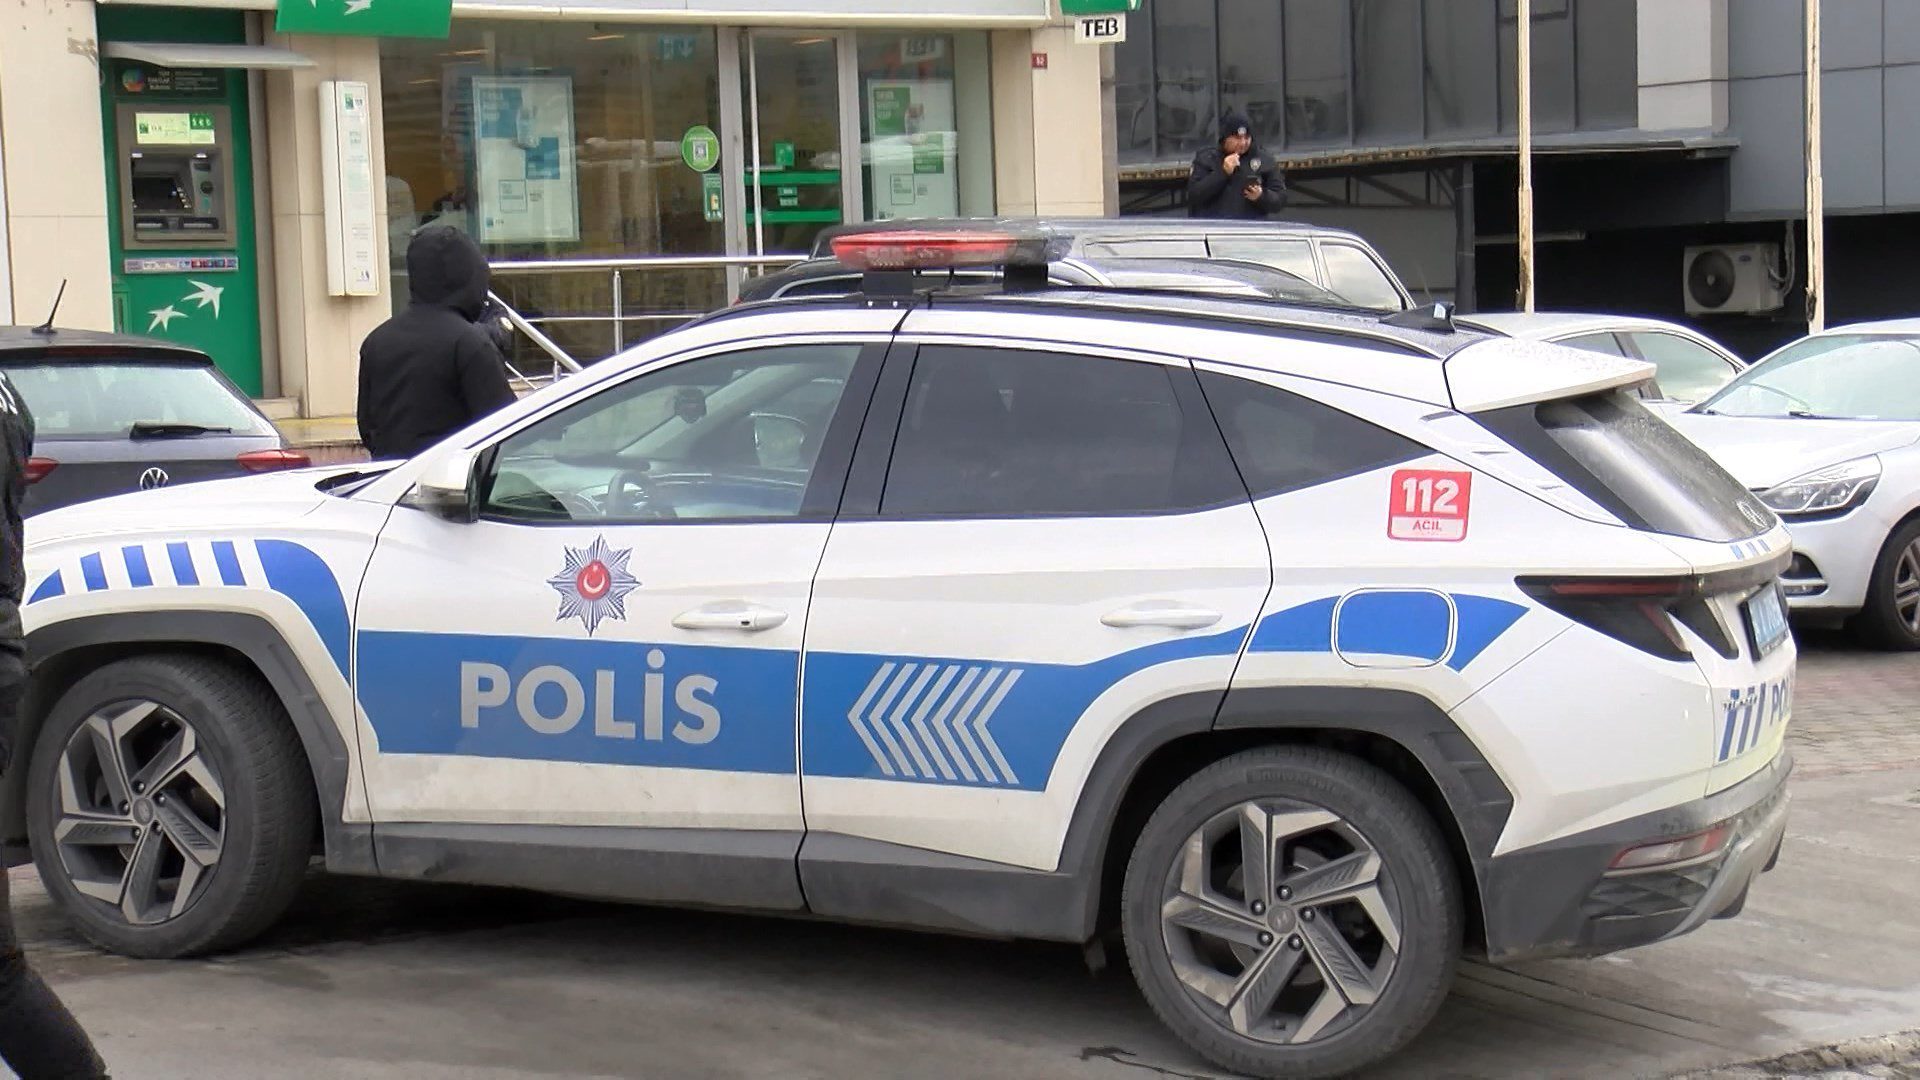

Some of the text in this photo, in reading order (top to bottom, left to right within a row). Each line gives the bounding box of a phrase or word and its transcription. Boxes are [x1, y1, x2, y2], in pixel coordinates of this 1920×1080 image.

[1082, 18, 1118, 37] TEB
[1402, 477, 1459, 515] 112
[461, 649, 721, 744] POLİS
